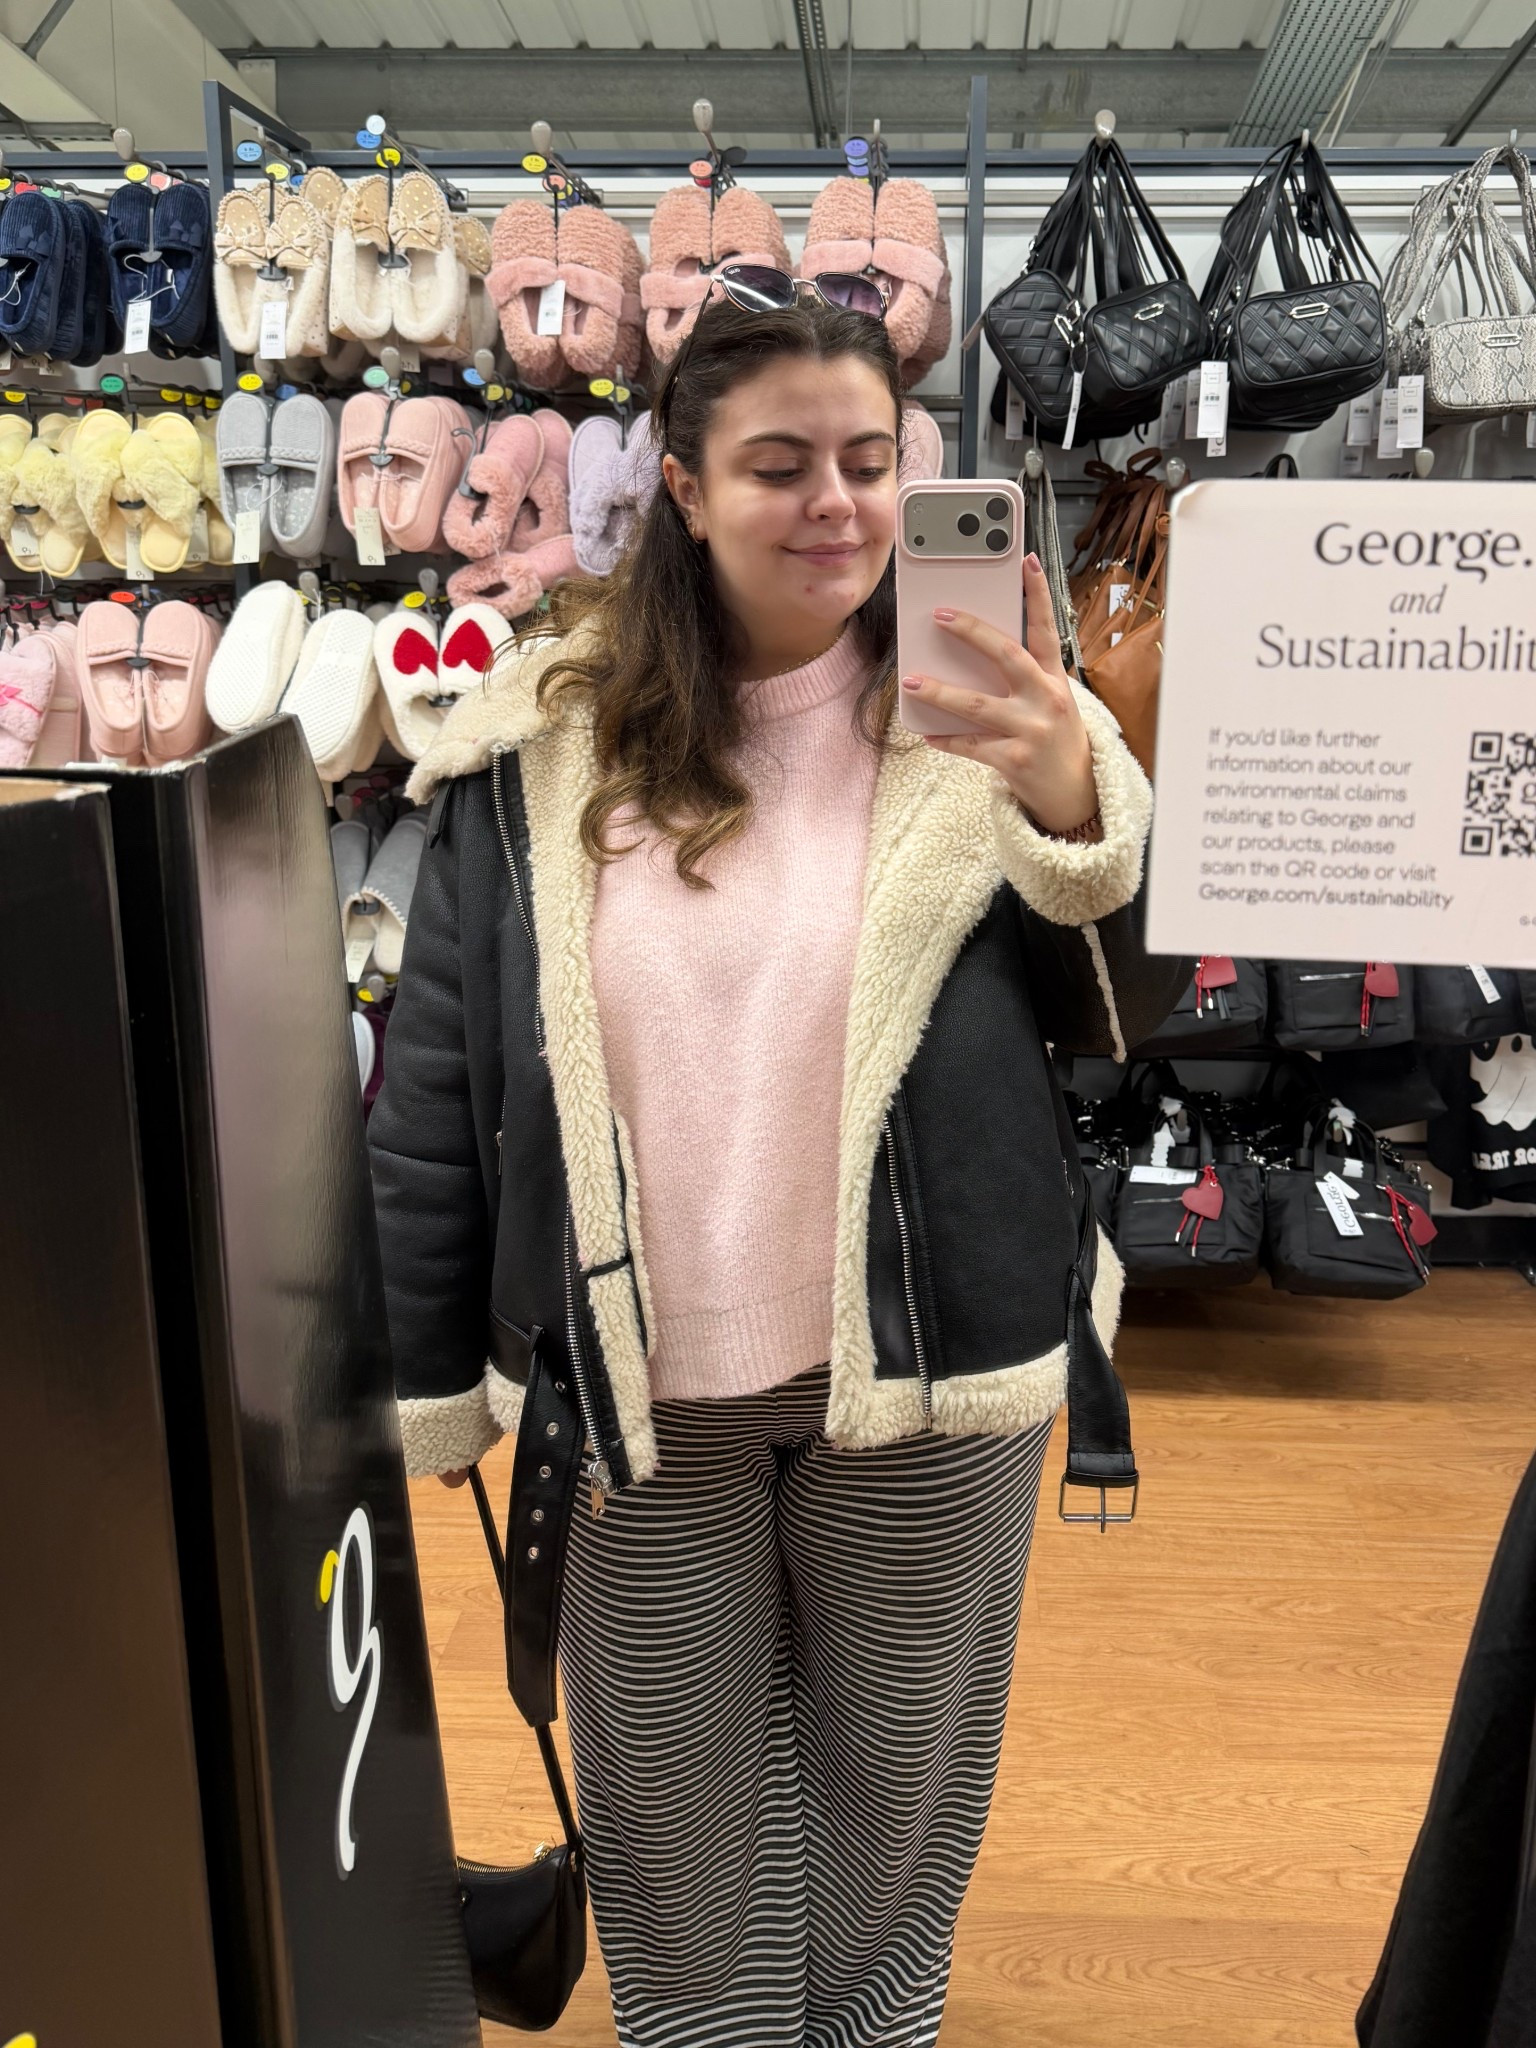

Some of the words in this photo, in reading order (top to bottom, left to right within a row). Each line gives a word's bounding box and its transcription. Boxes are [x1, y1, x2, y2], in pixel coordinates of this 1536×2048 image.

[1314, 522, 1534, 584] George.
[1389, 584, 1446, 614] and
[1209, 728, 1221, 745] If
[1225, 728, 1277, 748] you'd
[1280, 729, 1311, 747] like
[1316, 729, 1381, 748] further
[1207, 754, 1314, 773] information
[1318, 757, 1374, 775] about
[1378, 761, 1412, 776] our
[1205, 780, 1340, 800] environmental
[1345, 782, 1408, 802] claims
[1203, 807, 1273, 829] relating
[1278, 808, 1298, 826] to
[1301, 808, 1372, 831] George
[1377, 811, 1415, 830] and
[1201, 836, 1232, 850] our
[1238, 835, 1327, 854] products,
[1331, 836, 1396, 855] please
[1200, 861, 1246, 877] scan
[1250, 860, 1280, 877] the
[1285, 860, 1317, 878] QR
[1320, 863, 1369, 880] code
[1374, 866, 1395, 880] or
[1400, 864, 1436, 882] visit
[1199, 883, 1454, 911] George.com/sustainability
